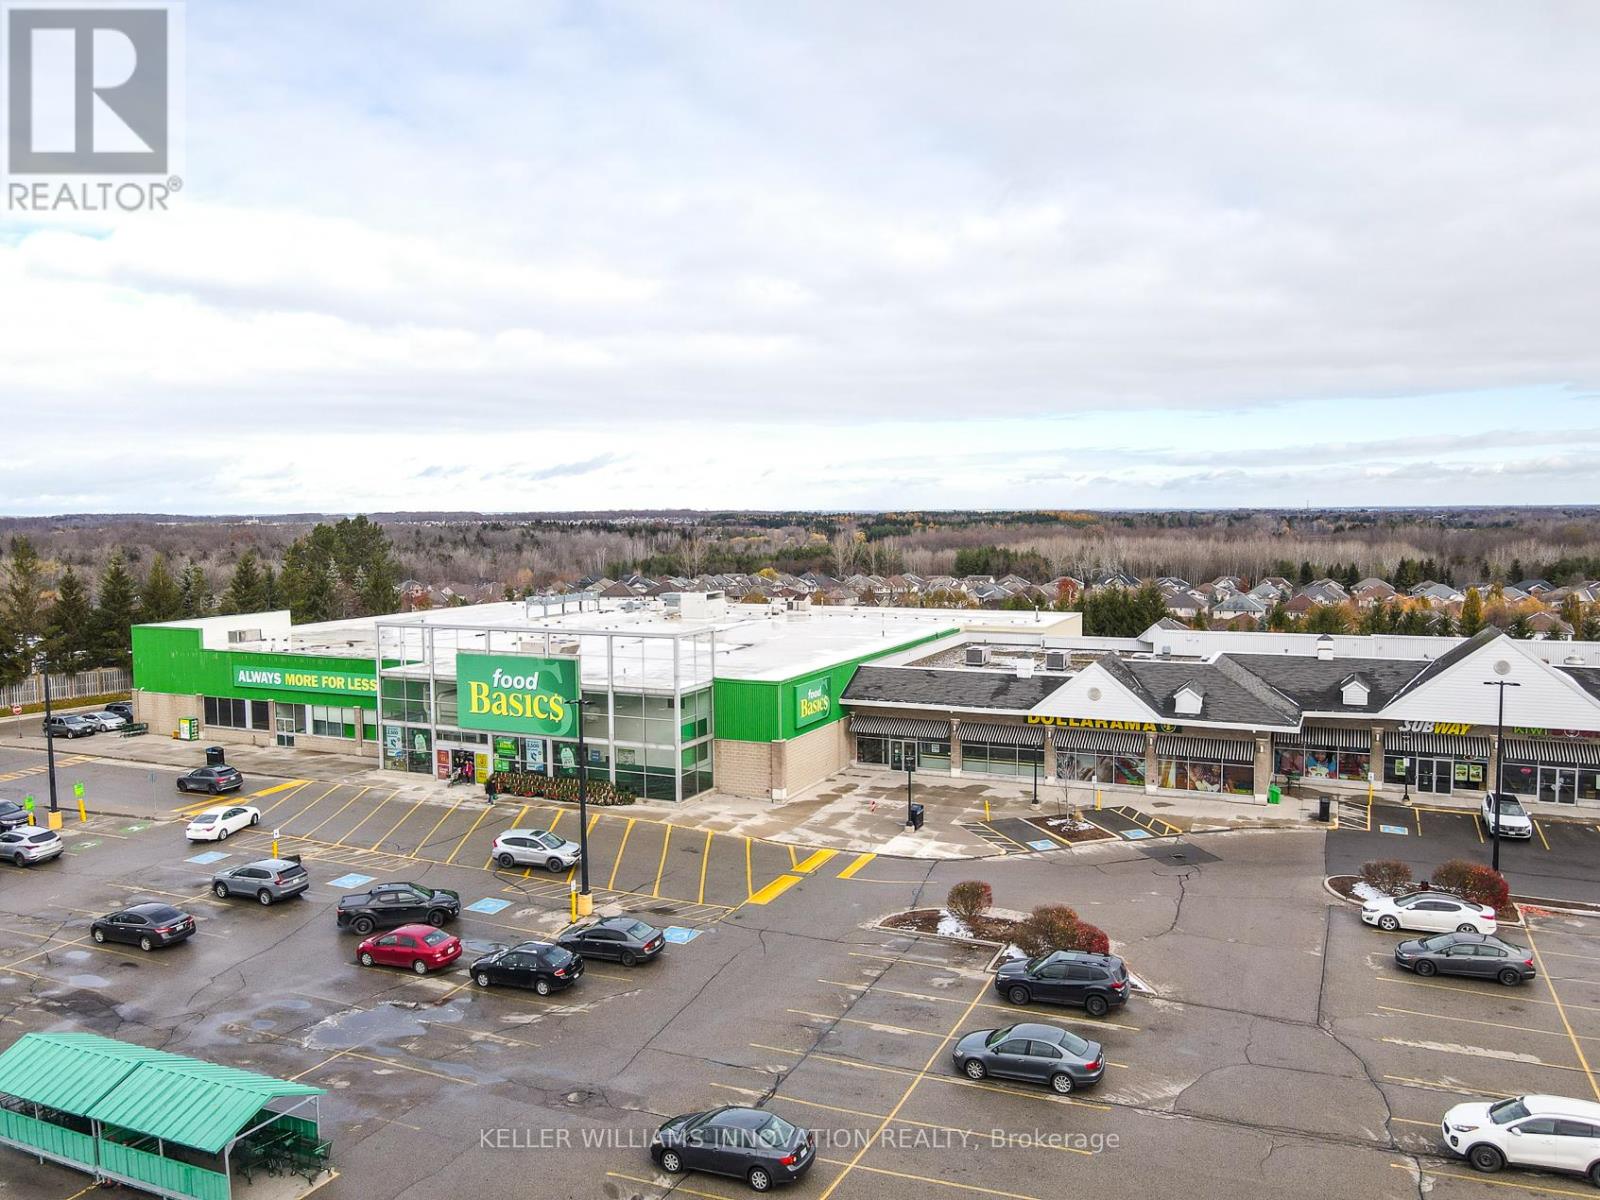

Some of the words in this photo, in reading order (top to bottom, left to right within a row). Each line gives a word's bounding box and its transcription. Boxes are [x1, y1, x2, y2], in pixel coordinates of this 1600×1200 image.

[238, 669, 281, 685] ALWAYS
[284, 673, 318, 688] MORE
[321, 676, 345, 690] FOR
[347, 678, 378, 692] LESS
[492, 668, 539, 690] food
[807, 685, 822, 700] food
[1027, 715, 1157, 732] DOLLARAMA
[1398, 720, 1470, 735] SUBWAY
